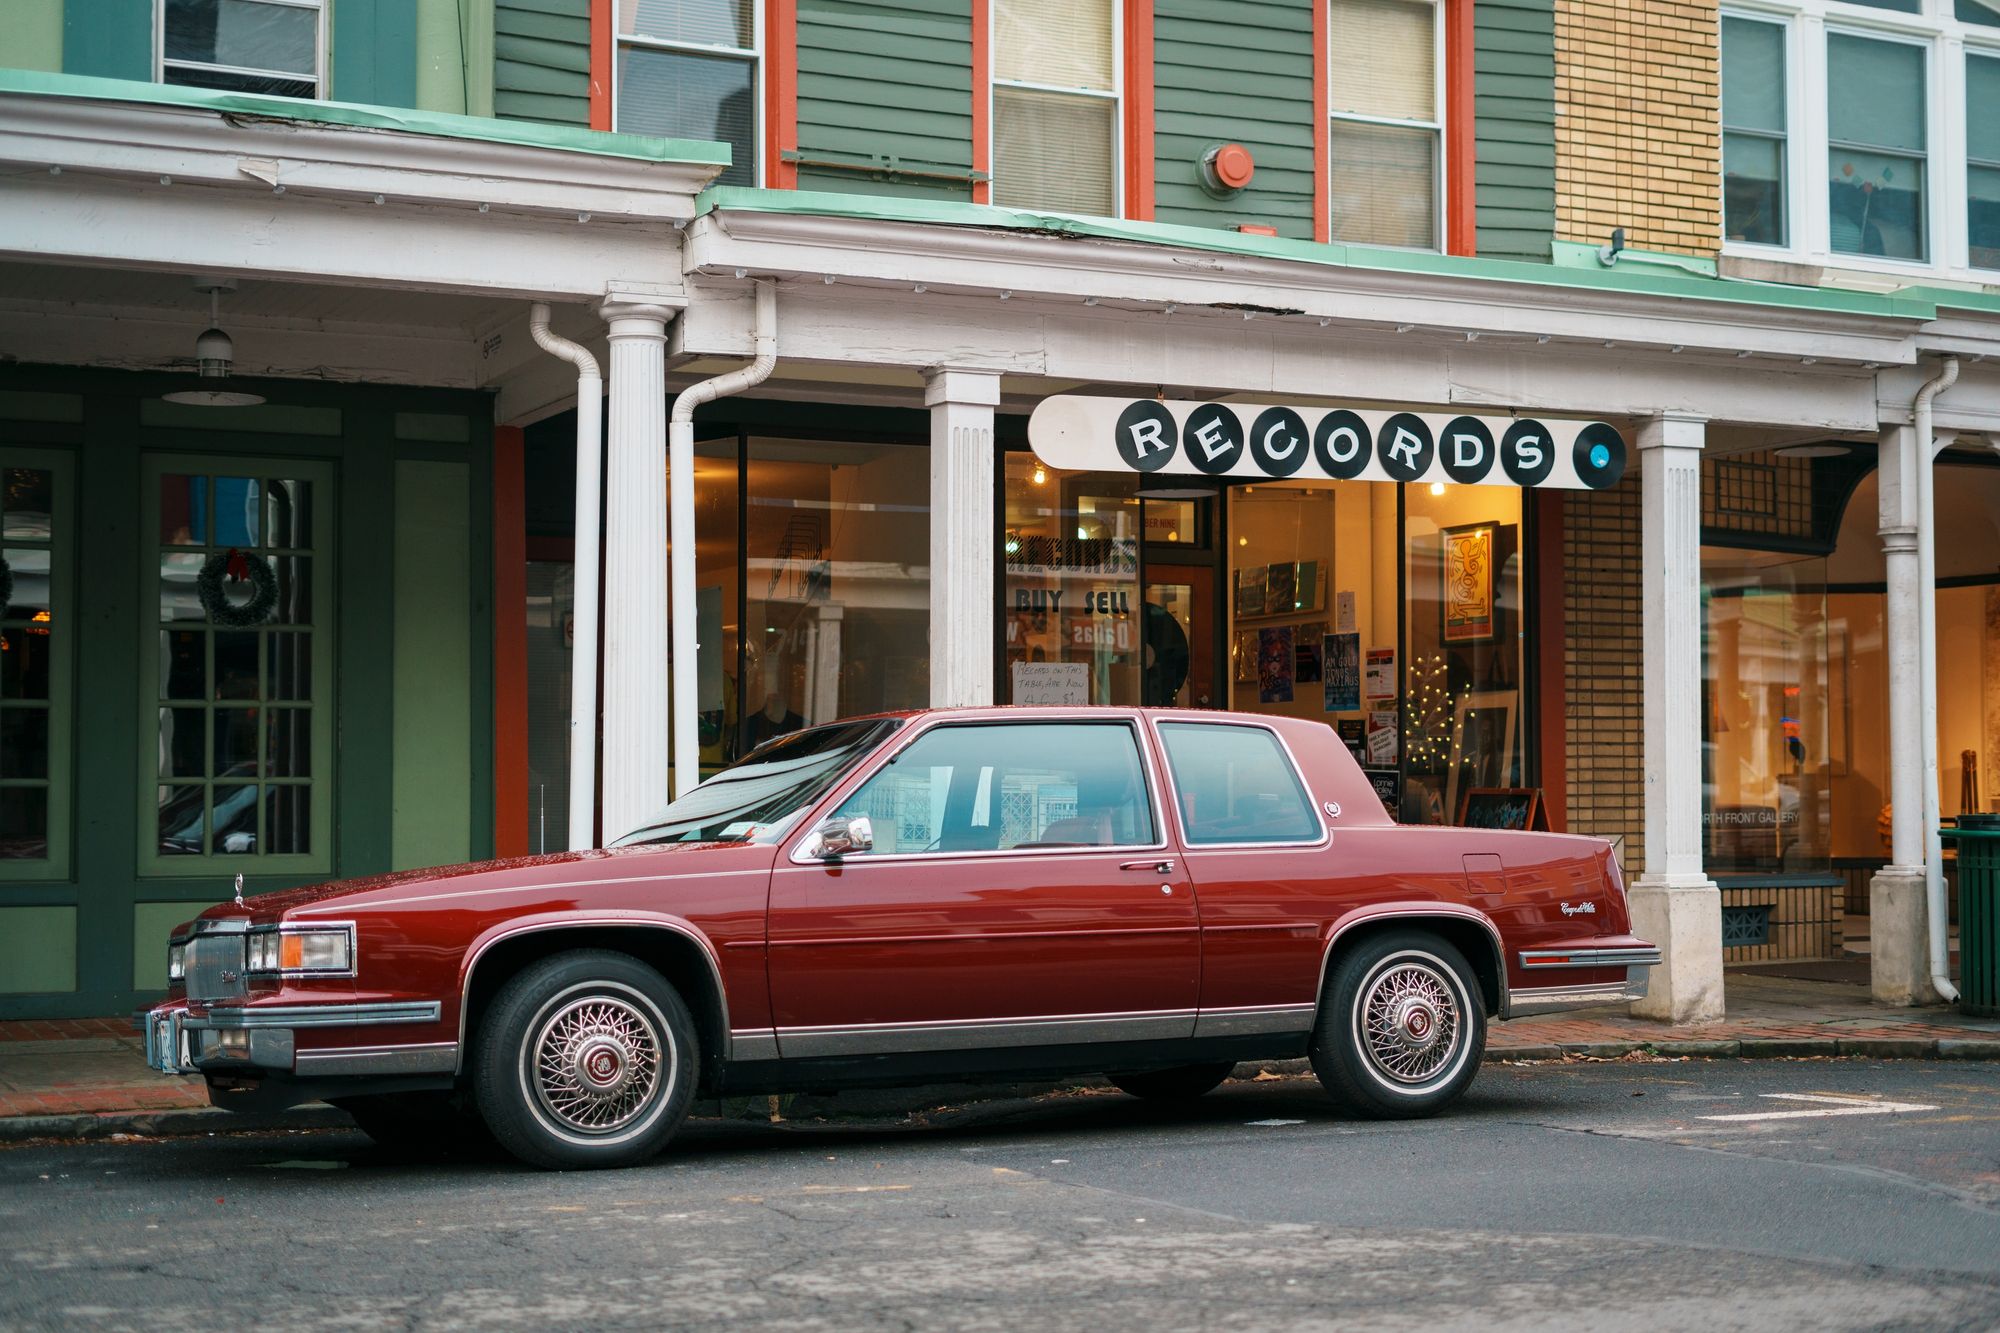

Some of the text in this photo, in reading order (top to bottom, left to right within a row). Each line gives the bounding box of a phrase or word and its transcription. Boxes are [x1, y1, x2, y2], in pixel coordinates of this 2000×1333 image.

[1128, 416, 1542, 471] RECORDS
[1160, 519, 1176, 529] NINE
[1007, 536, 1138, 574] RECORDS
[1016, 589, 1129, 614] BUY SELL
[1701, 811, 1799, 824] RTH FRONT GALLERY
